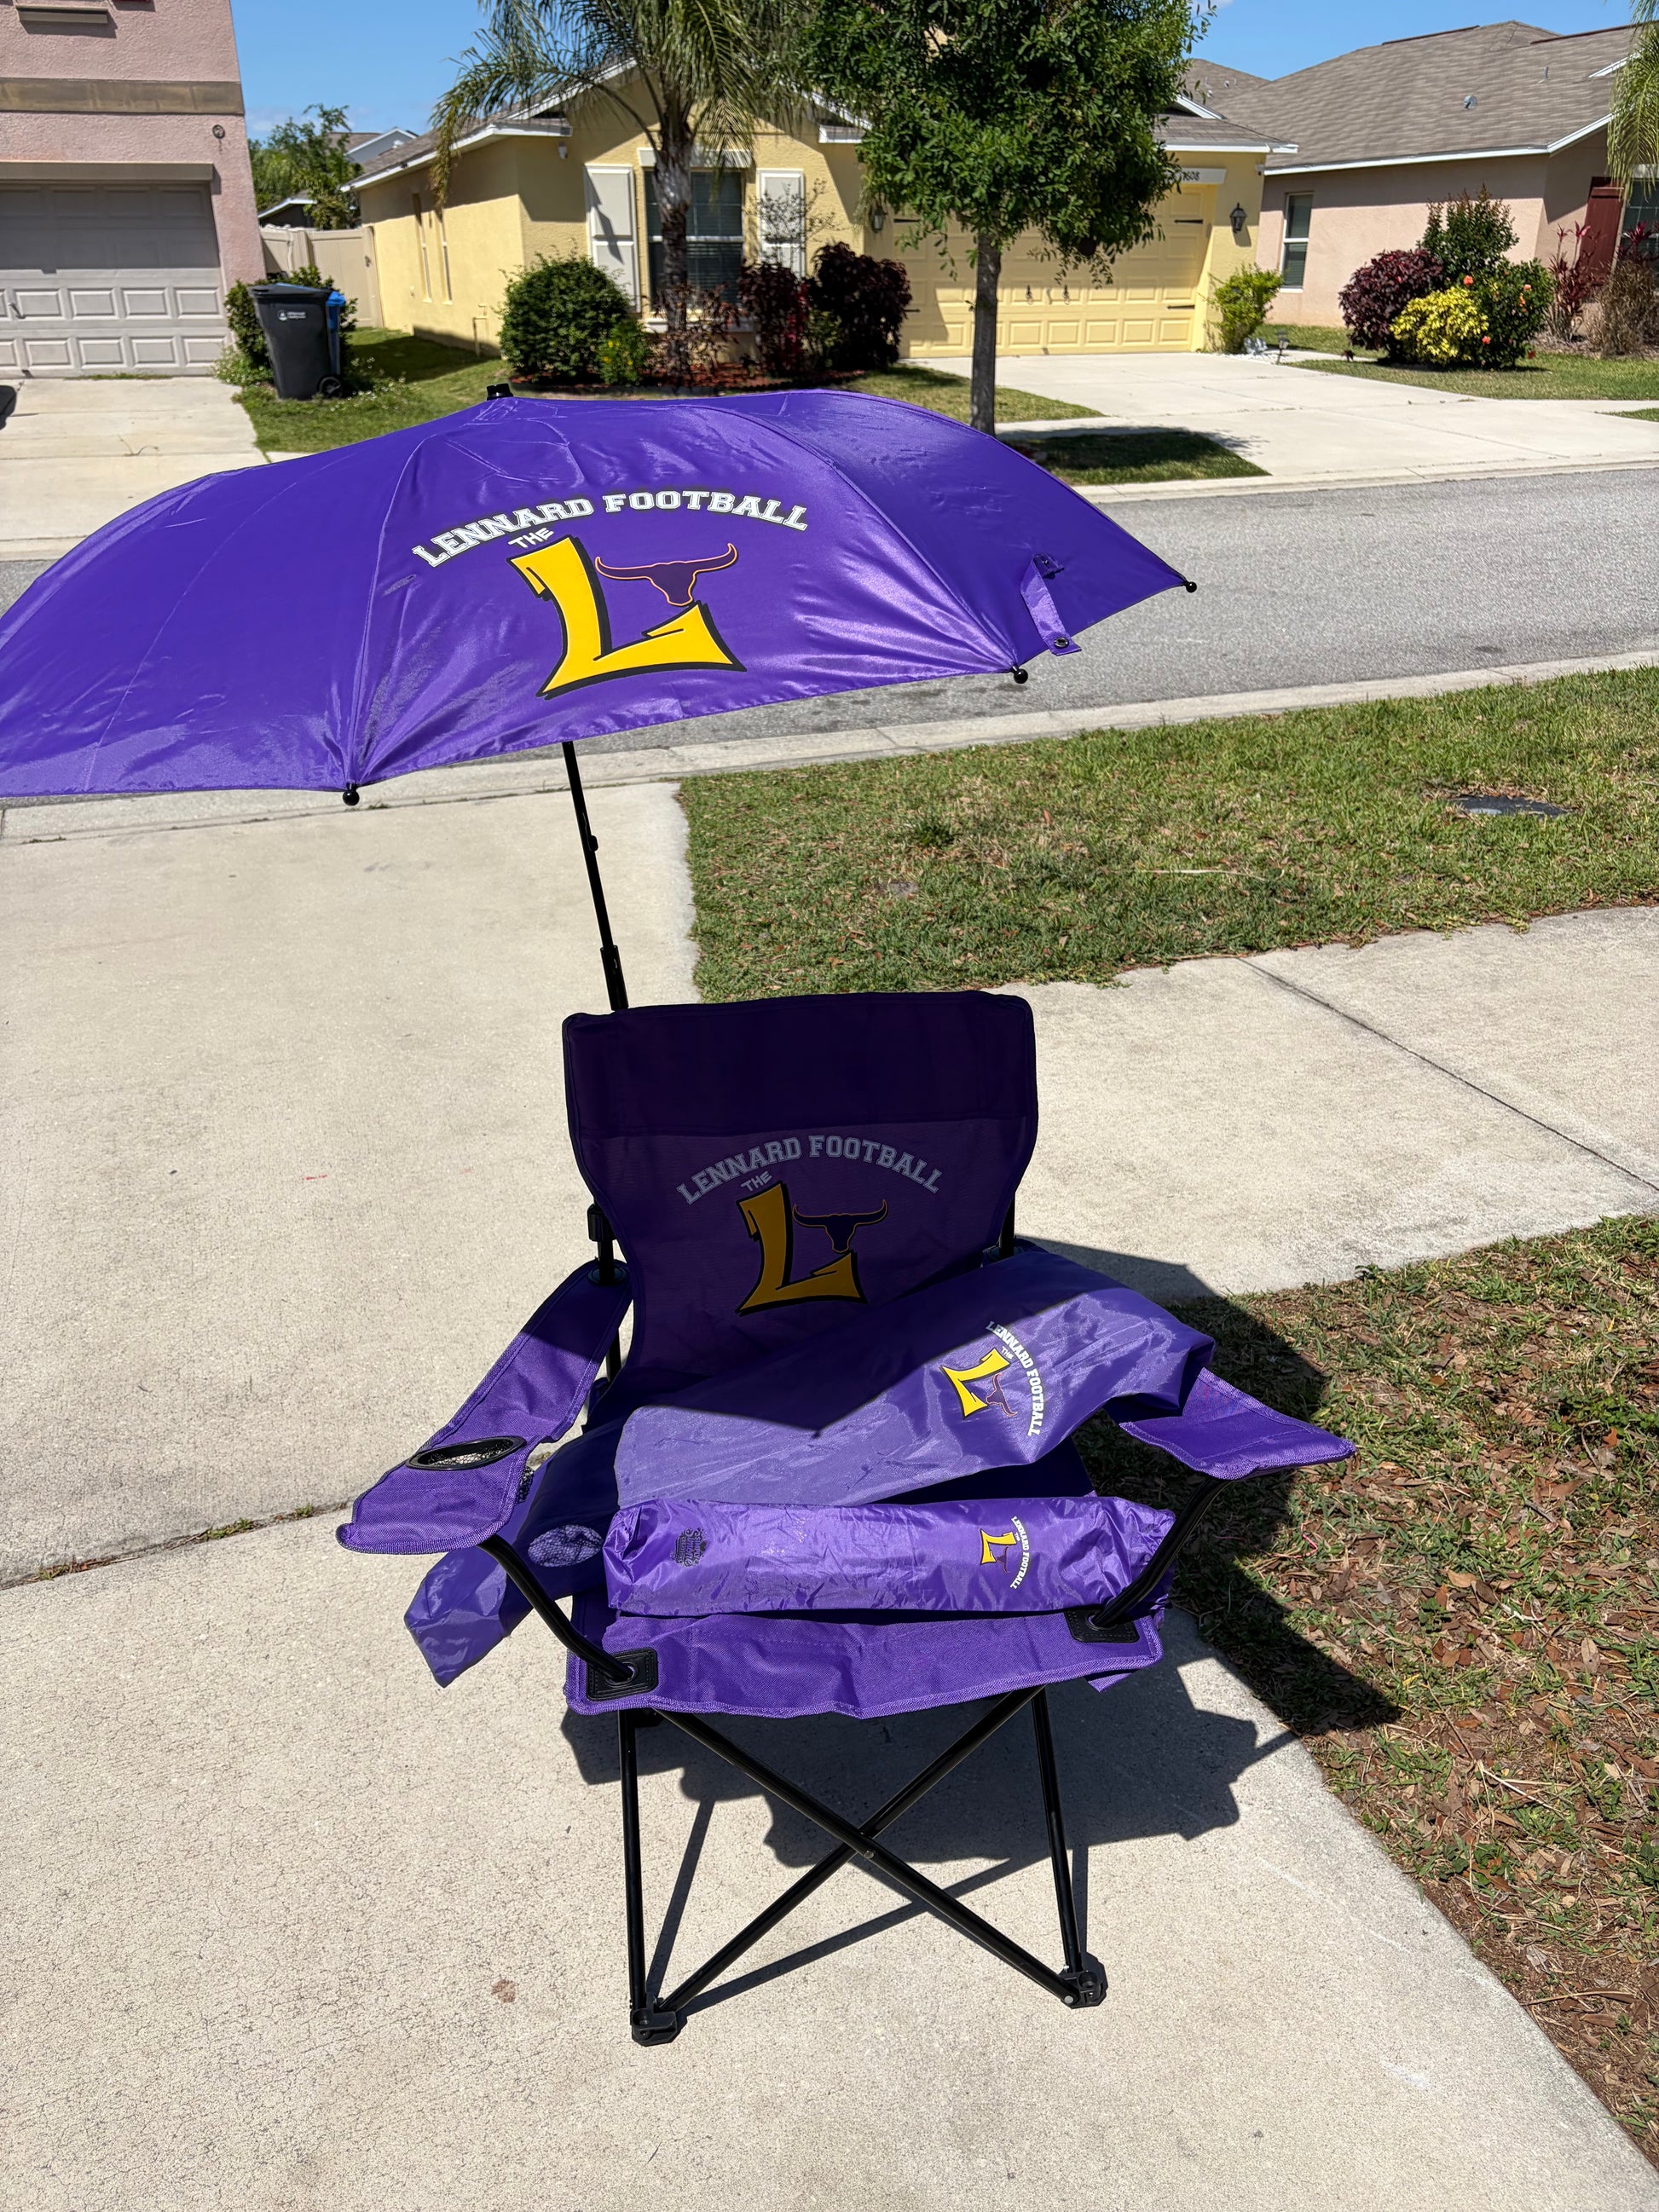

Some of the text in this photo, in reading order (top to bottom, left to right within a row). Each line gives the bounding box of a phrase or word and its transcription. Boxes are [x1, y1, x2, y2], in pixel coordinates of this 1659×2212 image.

[412, 490, 808, 568] LENNARD FOOTBALL
[507, 527, 555, 549] THE
[676, 1135, 942, 1204] LENNARD FOOTBALL
[741, 1170, 772, 1193] THE
[986, 1321, 1044, 1436] LENNARD FOOTBALL
[1001, 1346, 1014, 1360] THE
[1010, 1516, 1029, 1589] LENNARD FOOTBALL
